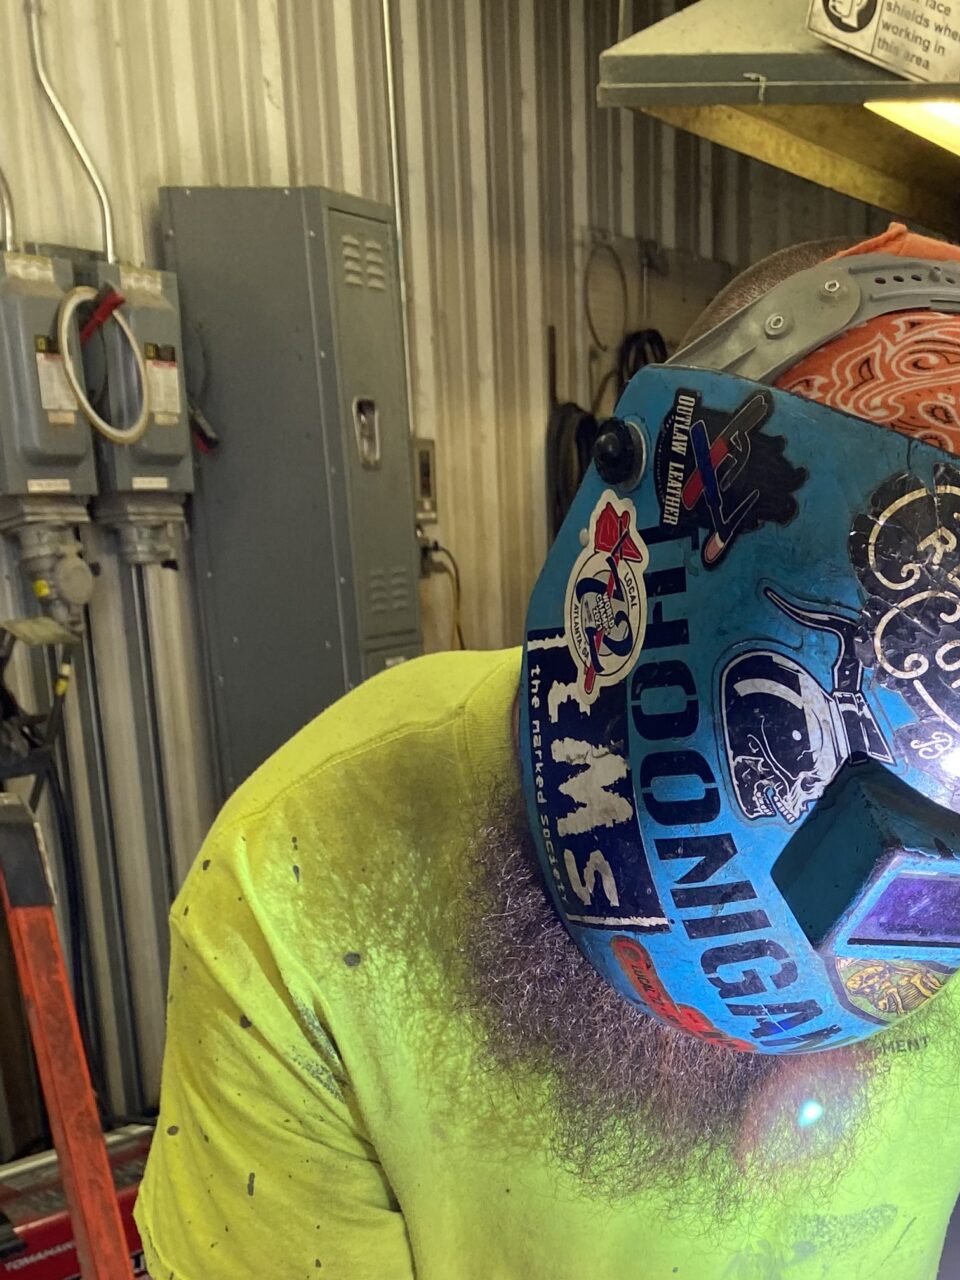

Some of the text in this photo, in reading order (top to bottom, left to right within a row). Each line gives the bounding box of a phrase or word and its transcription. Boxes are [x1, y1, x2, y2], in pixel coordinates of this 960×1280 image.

[885, 1, 930, 28] shields
[877, 36, 930, 70] this area
[881, 19, 946, 57] working in
[671, 394, 696, 457] OUTLAW
[662, 460, 685, 526] LEATHER
[624, 571, 639, 610] LOCAL
[592, 608, 603, 632] 2021
[602, 591, 616, 629] WORLD
[529, 664, 540, 710] the
[539, 814, 569, 904] society
